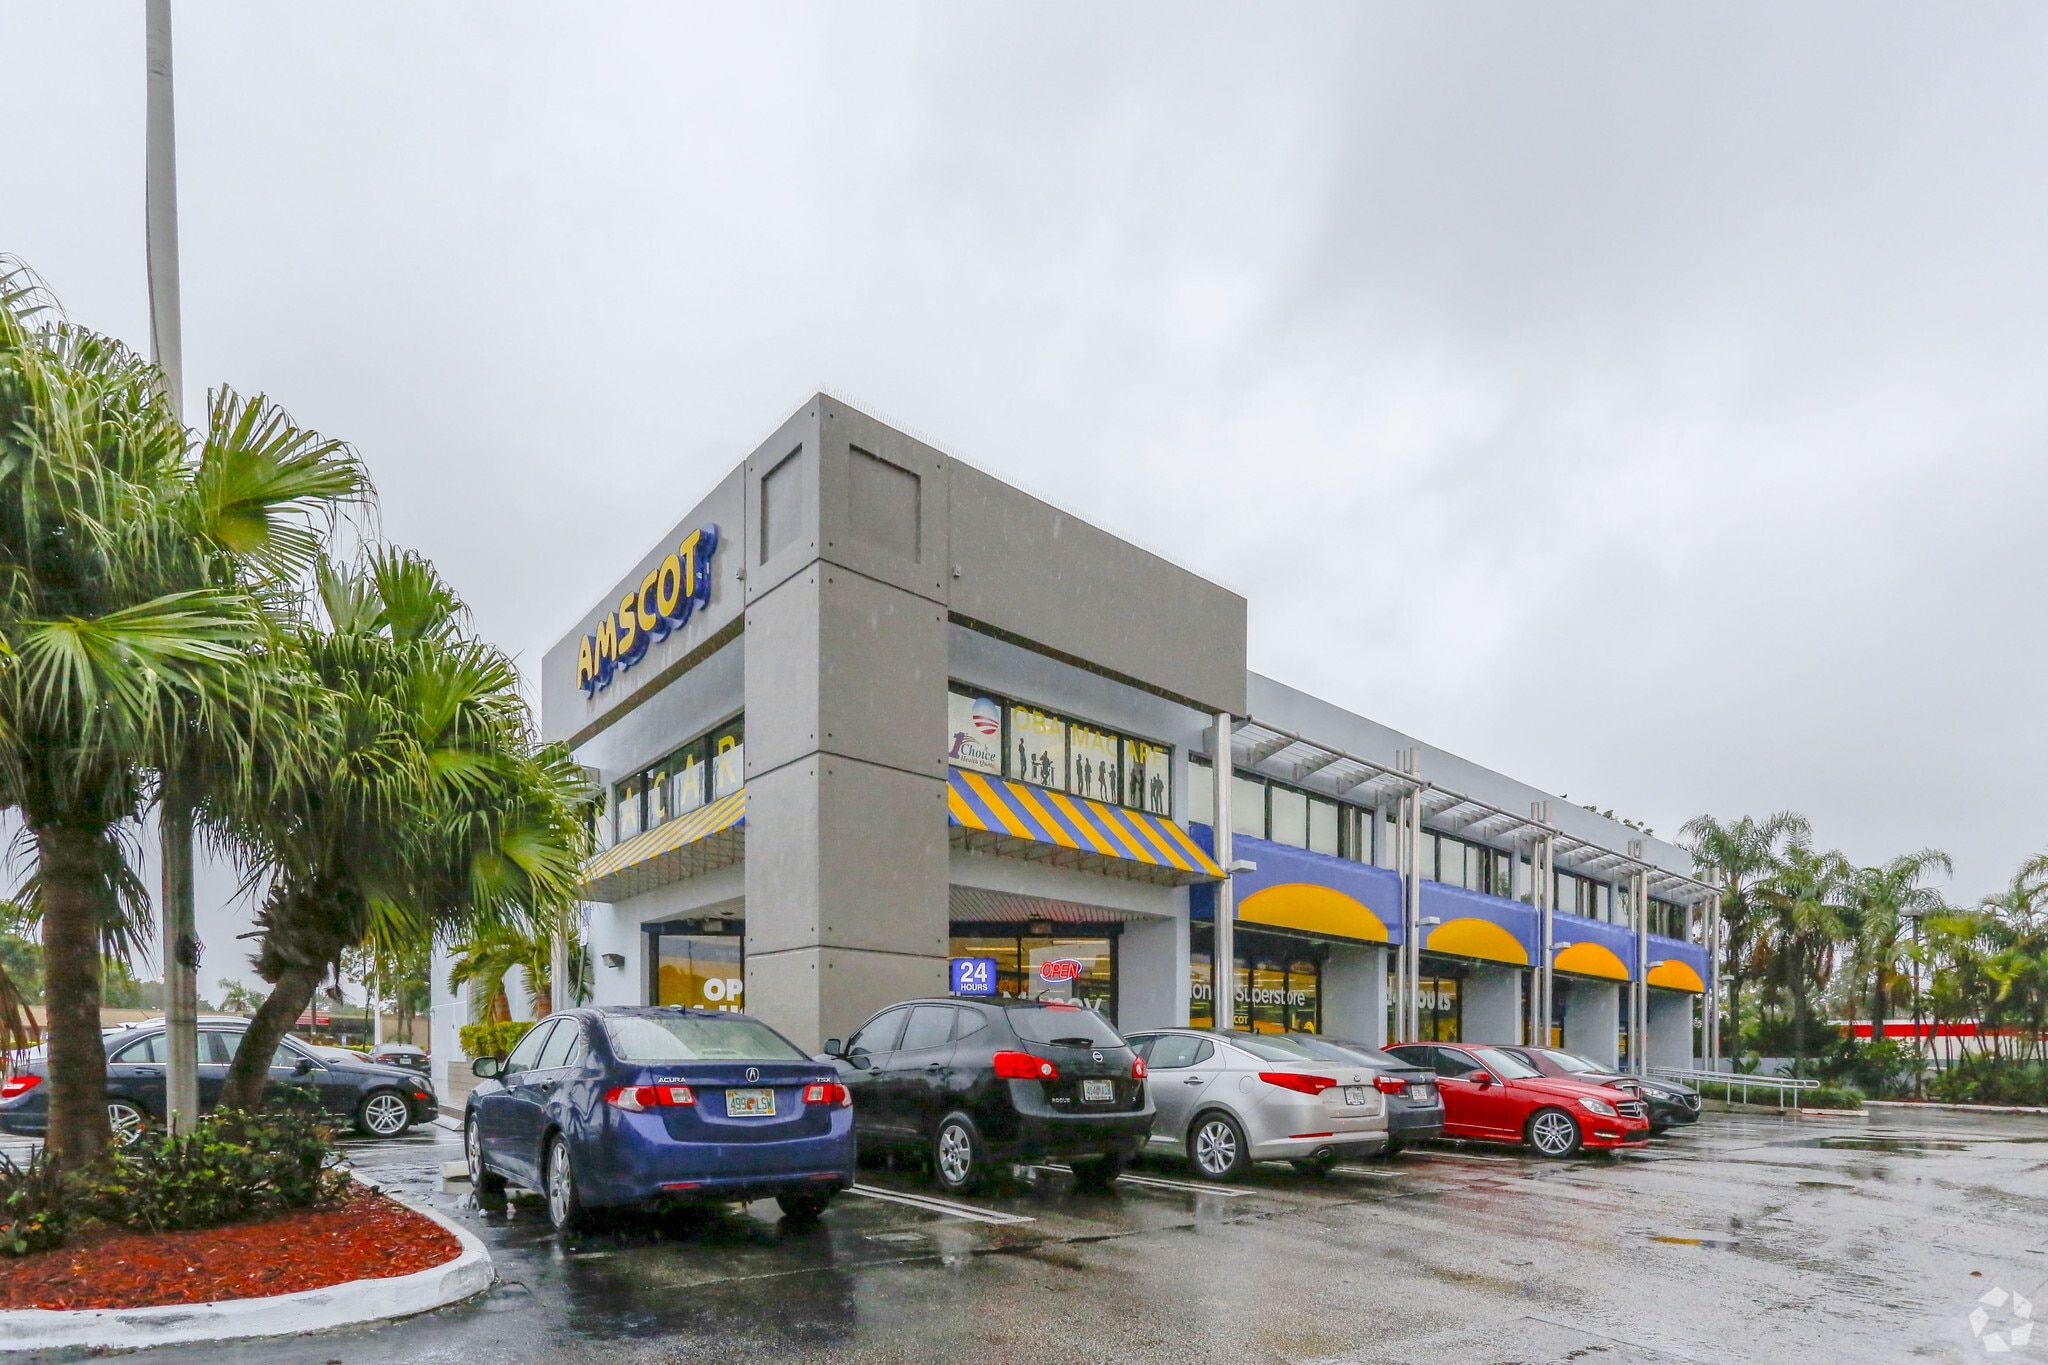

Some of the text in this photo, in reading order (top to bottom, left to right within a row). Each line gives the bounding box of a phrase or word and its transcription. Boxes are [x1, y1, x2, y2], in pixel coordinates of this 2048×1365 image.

[576, 526, 706, 692] AMSCOT
[960, 743, 996, 762] Choice
[960, 961, 988, 983] 24
[1040, 961, 1080, 980] OPEN
[703, 978, 743, 1001] OP
[960, 983, 988, 991] HOURS
[1235, 985, 1305, 1007] Superstore
[1234, 1015, 1249, 1024] COT
